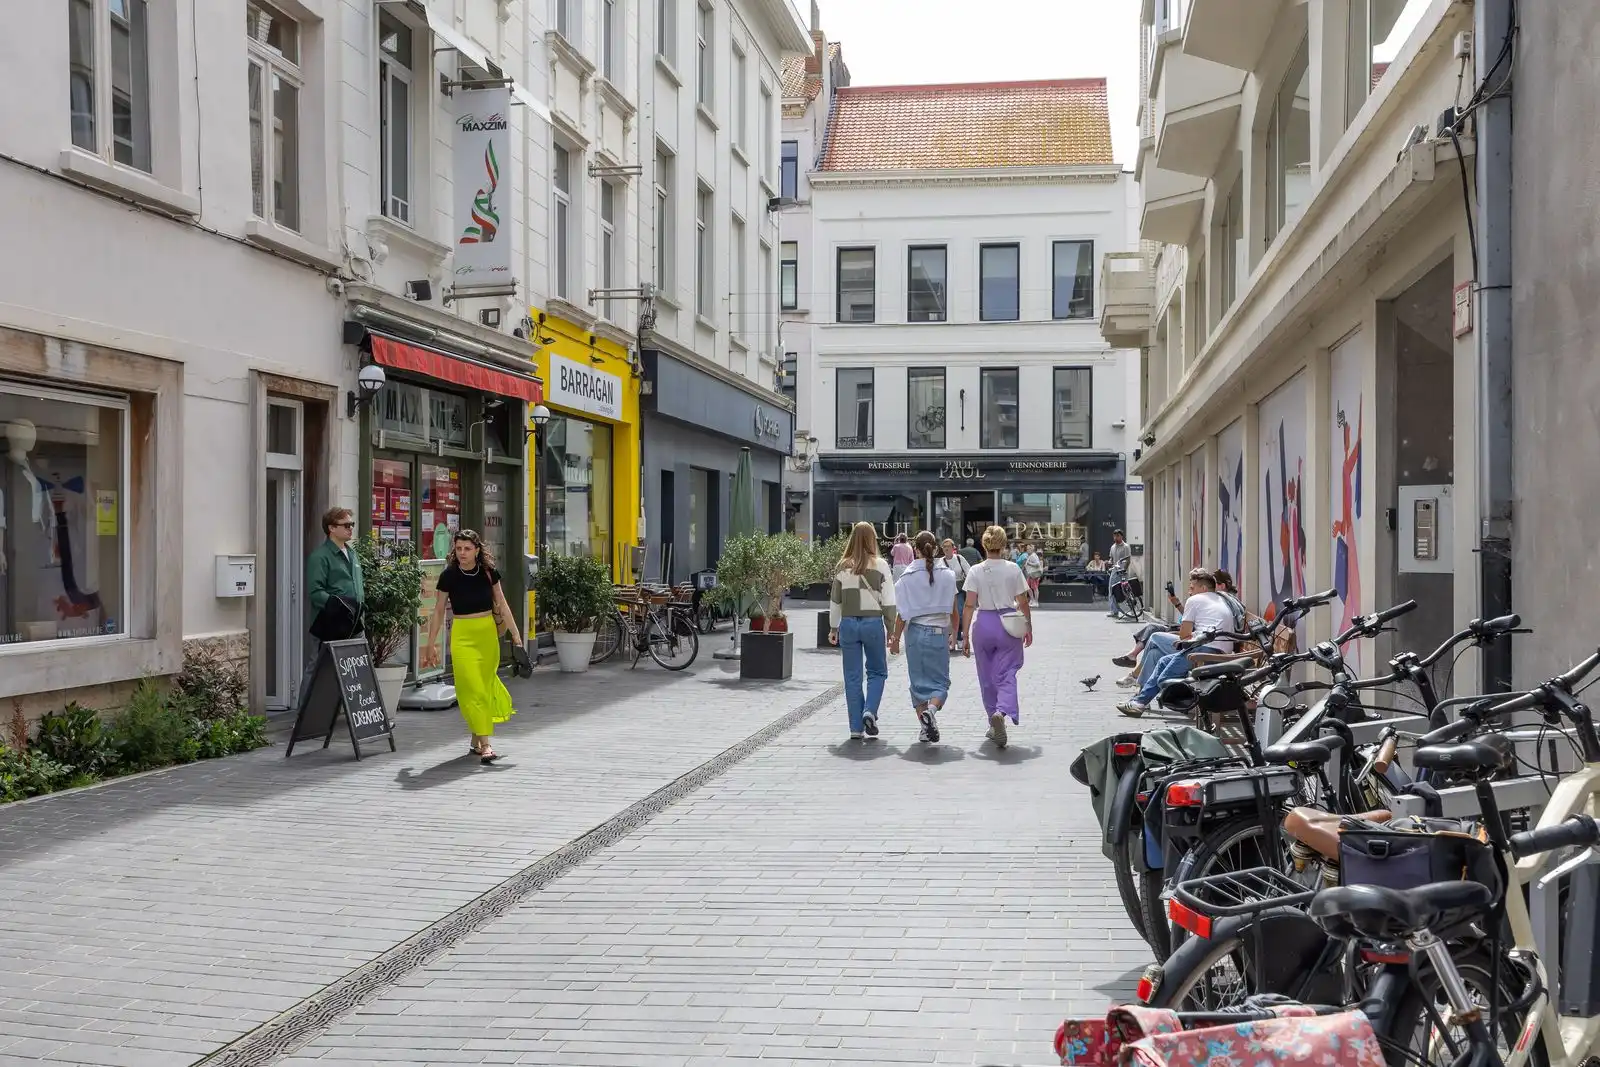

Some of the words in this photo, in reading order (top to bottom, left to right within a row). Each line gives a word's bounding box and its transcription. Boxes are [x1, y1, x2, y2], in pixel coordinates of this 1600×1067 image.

[462, 121, 507, 132] MAXZIM
[868, 460, 910, 469] PÂTISSERIE
[1010, 461, 1067, 469] VIENNOISERIE
[1014, 522, 1083, 540] PAUL
[339, 654, 368, 678] SUPPORT
[359, 690, 376, 707] local
[352, 706, 385, 728] DREAMERS
